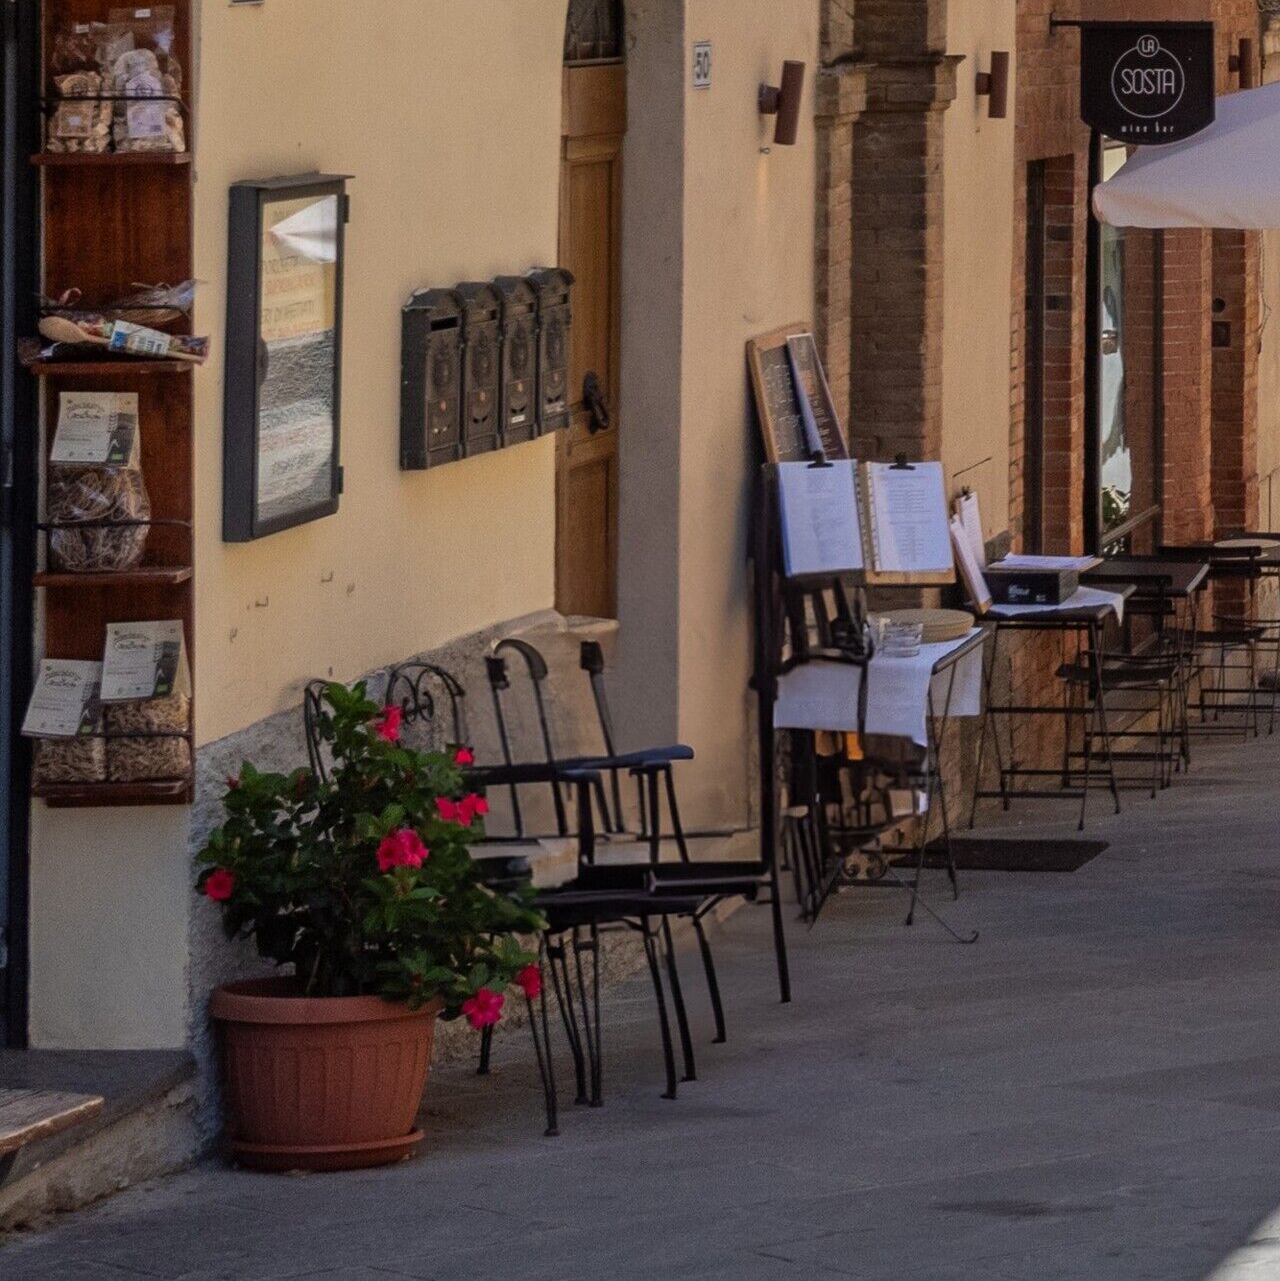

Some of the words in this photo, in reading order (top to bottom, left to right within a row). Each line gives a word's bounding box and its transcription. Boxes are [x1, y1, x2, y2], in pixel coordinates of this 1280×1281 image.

[1141, 39, 1155, 53] LA
[696, 51, 710, 80] 50
[1121, 68, 1175, 95] SOSTA
[1121, 123, 1148, 133] wine
[1155, 121, 1175, 133] bar
